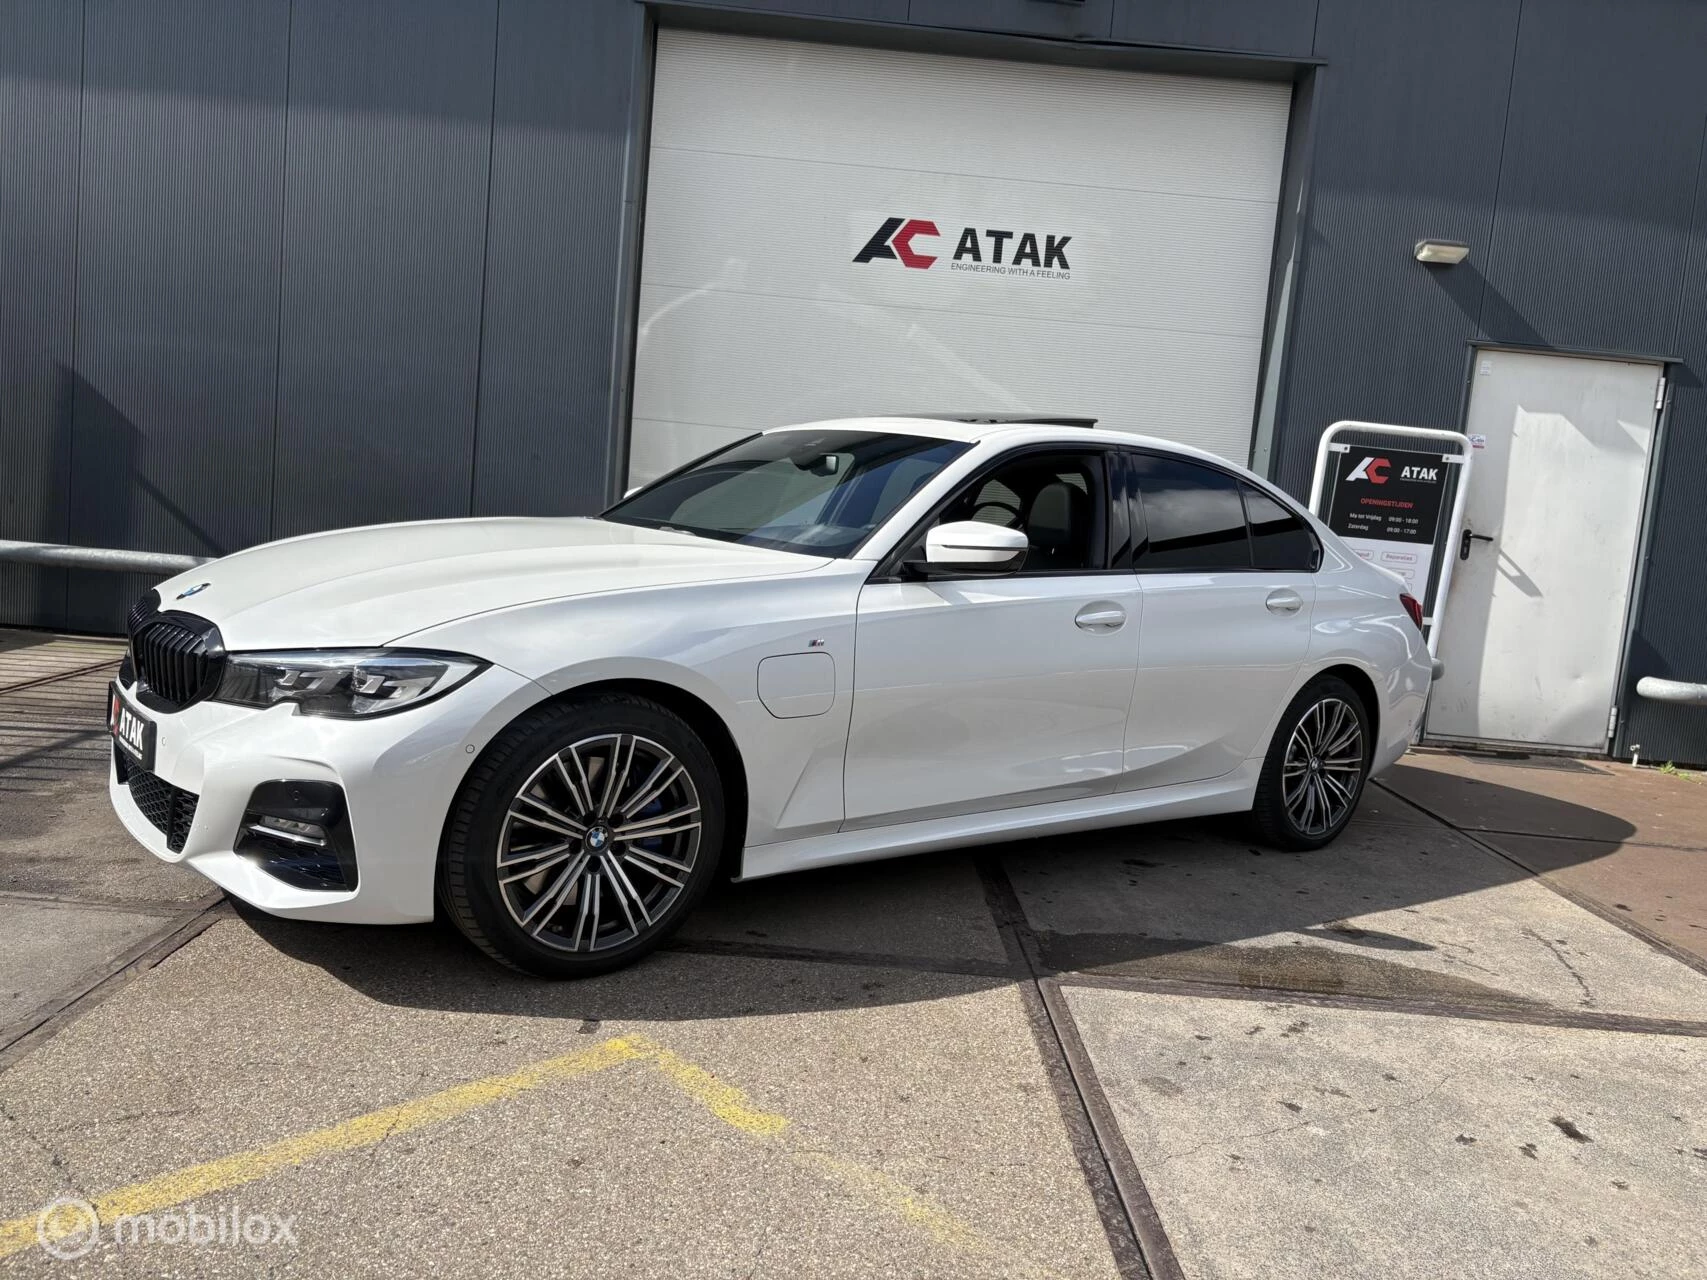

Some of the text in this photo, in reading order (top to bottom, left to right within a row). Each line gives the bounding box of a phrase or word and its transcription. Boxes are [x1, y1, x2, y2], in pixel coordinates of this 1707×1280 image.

[953, 227, 1073, 270] ATAK
[951, 262, 1071, 280] ENGINEERING WITH A FEELING
[1400, 466, 1439, 481] ATAK
[1360, 497, 1414, 509] OPENINGSTIJDEN
[120, 707, 144, 751] ATAK
